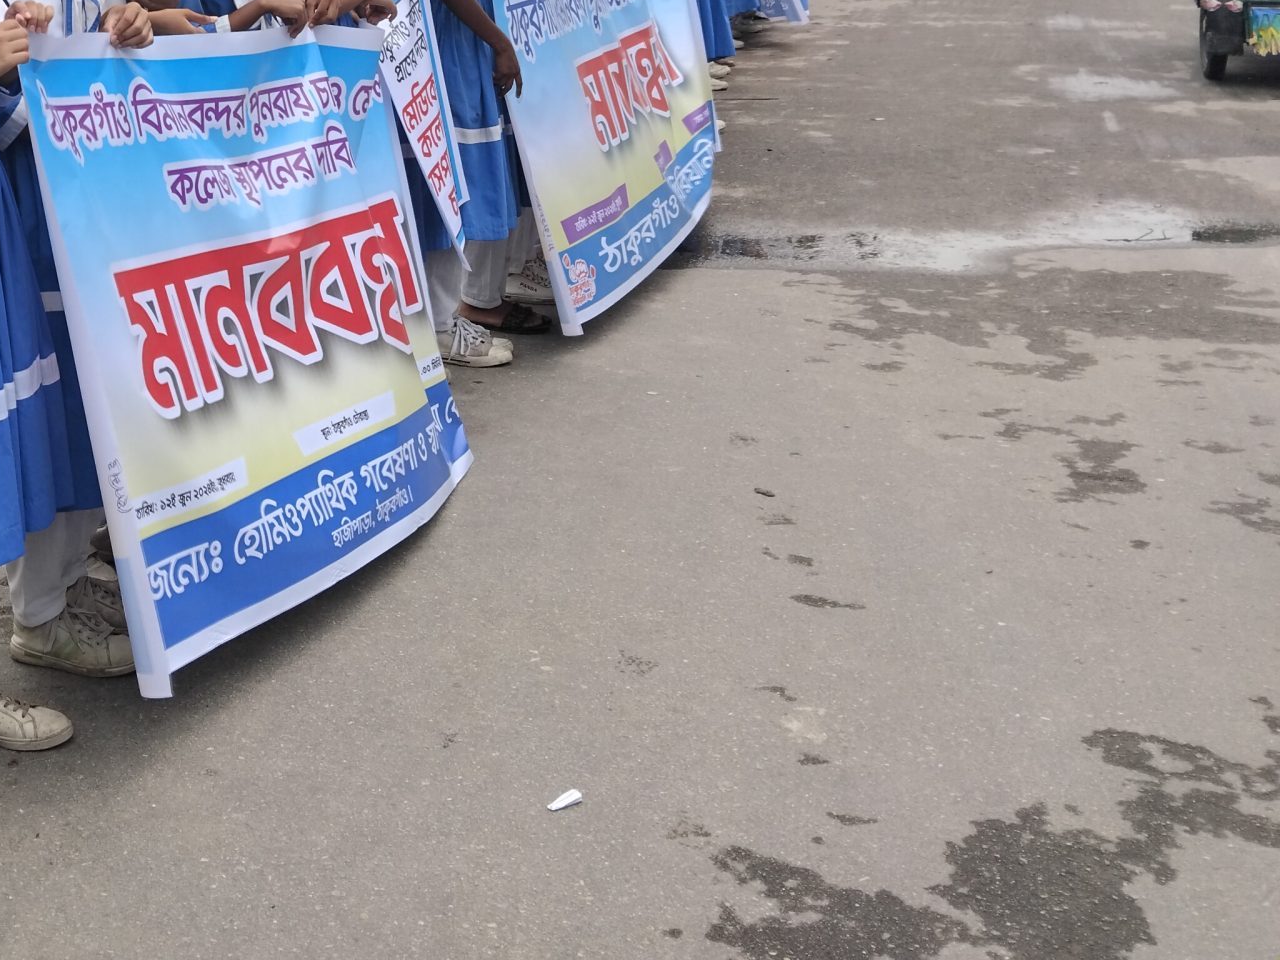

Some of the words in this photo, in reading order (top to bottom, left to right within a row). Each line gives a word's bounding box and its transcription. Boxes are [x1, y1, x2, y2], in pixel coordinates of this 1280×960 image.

[132, 83, 247, 138] বিমানবন্দর
[249, 82, 315, 137] পুনরায়
[599, 195, 680, 273] ঠাকুরগাঁও
[234, 469, 359, 566] হোমিওপ্যাথিক
[360, 438, 419, 492] গবেষণা
